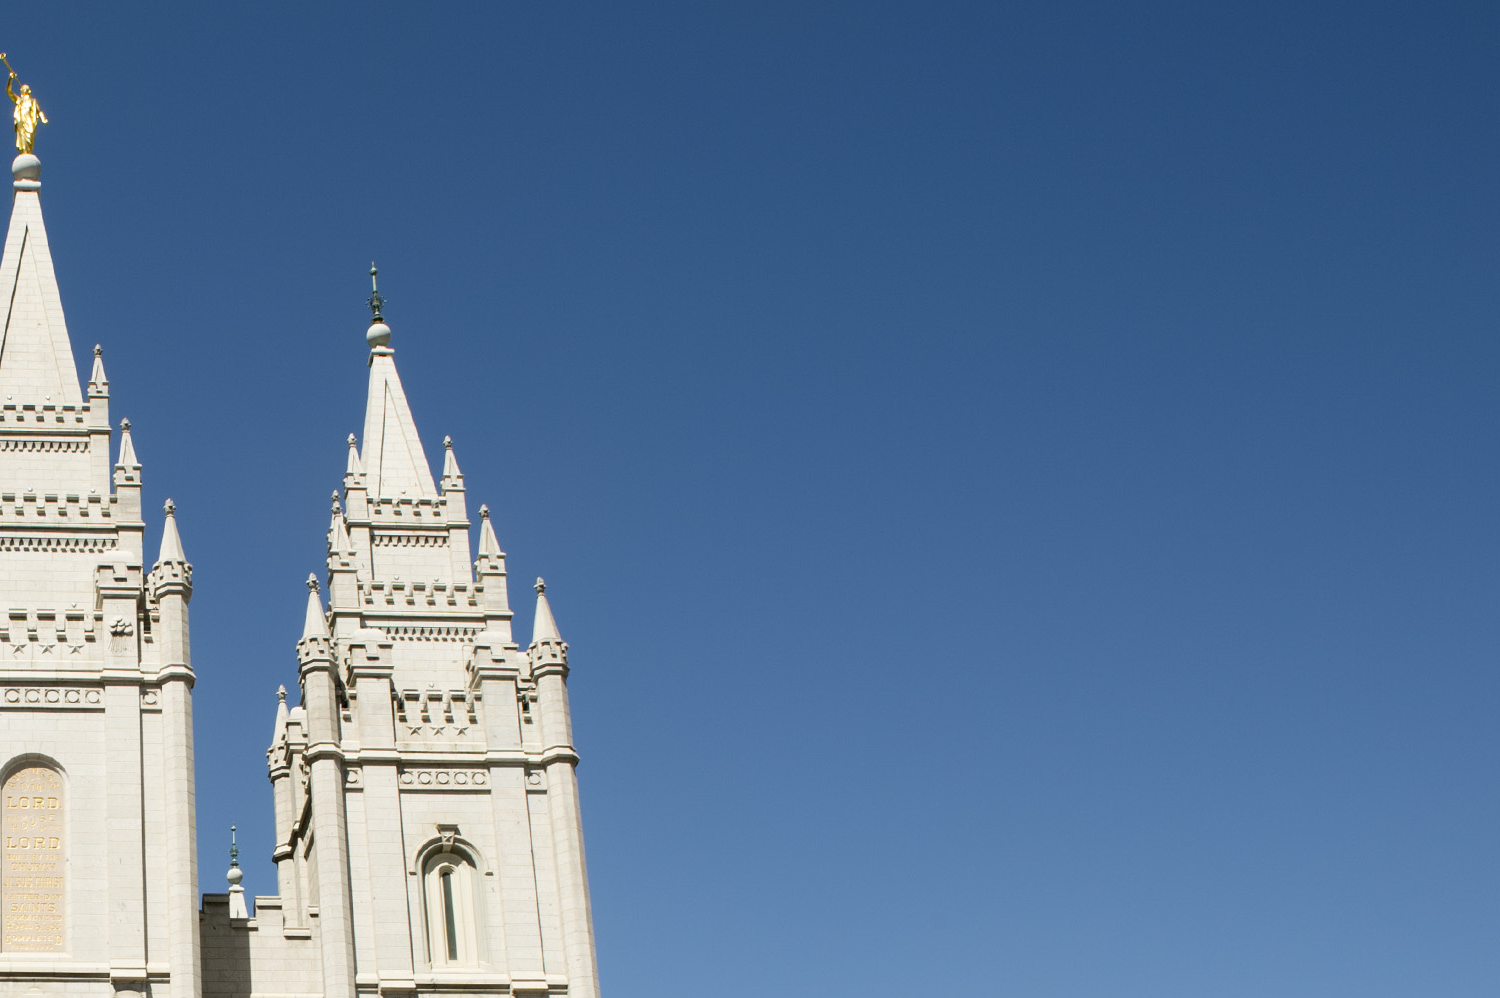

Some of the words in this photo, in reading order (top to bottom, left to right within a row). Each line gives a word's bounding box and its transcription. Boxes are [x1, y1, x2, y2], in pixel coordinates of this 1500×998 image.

[7, 796, 63, 809] LORD.
[6, 836, 60, 849] LORD
[11, 902, 58, 912] SAINTS.
